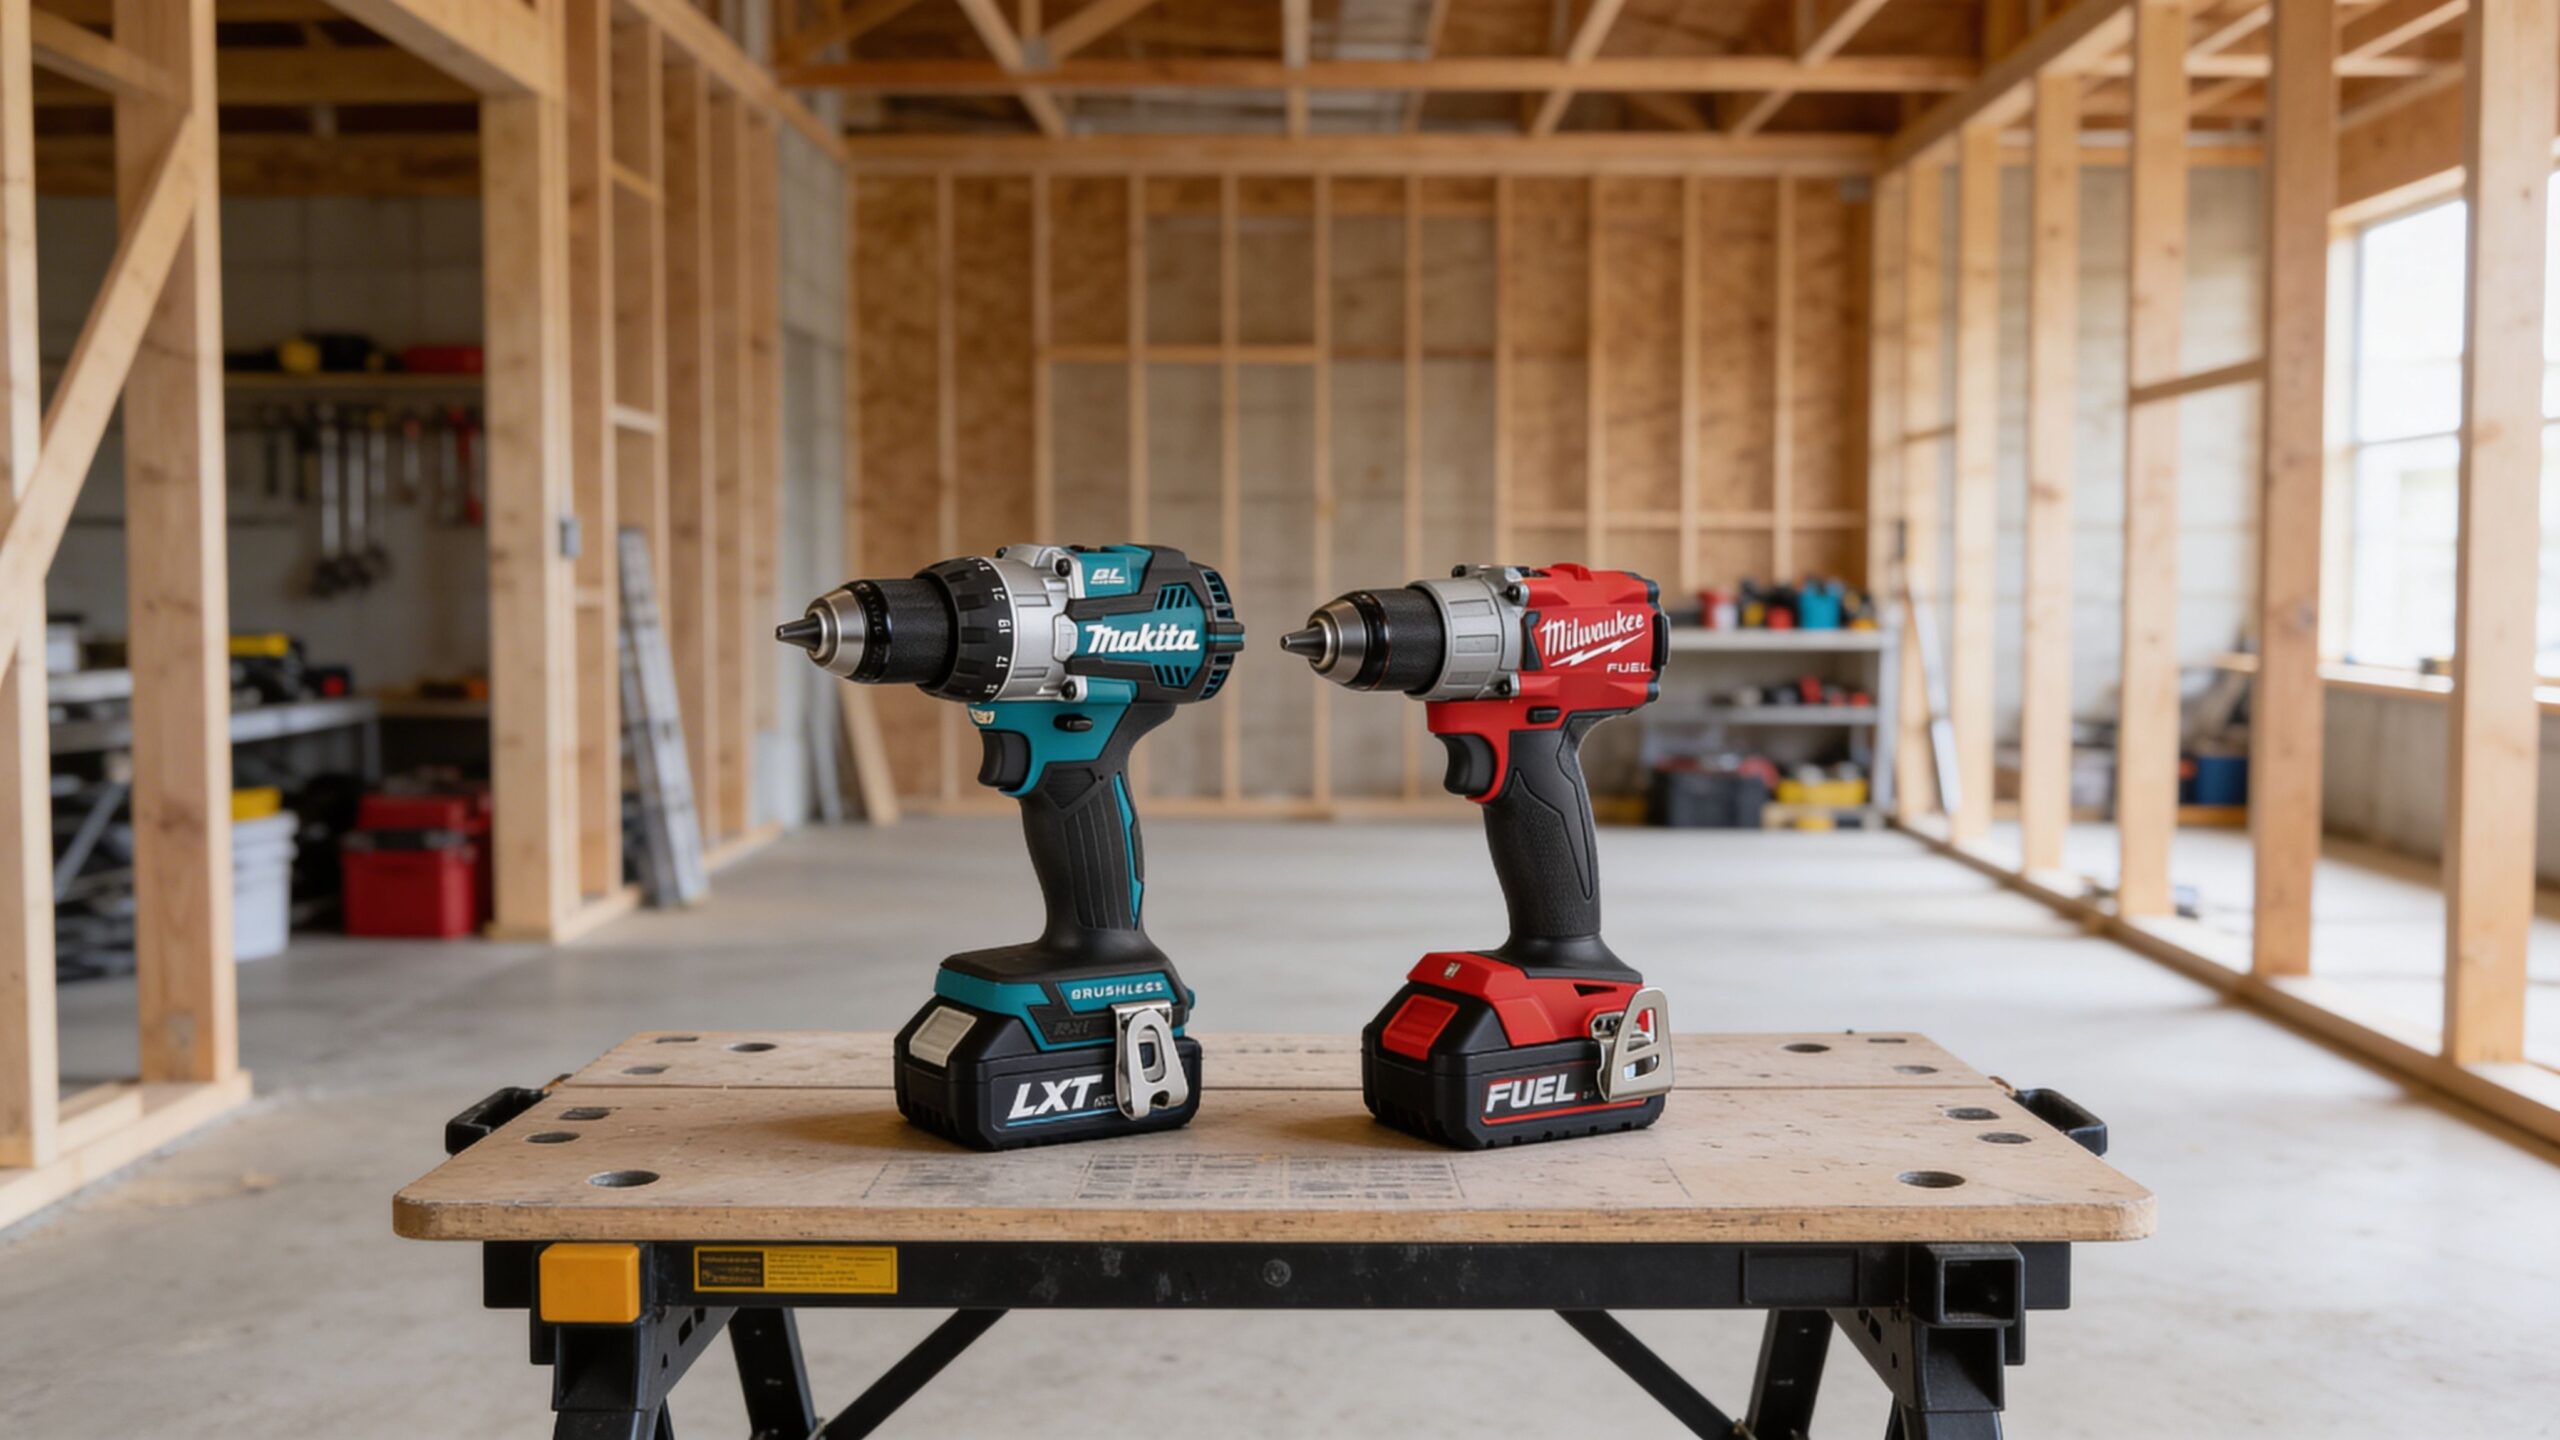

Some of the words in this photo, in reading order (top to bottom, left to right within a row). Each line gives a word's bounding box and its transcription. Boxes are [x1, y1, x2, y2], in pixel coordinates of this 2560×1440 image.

[1085, 623, 1200, 654] Makita
[1540, 609, 1645, 657] Milwaukee
[1606, 662, 1650, 673] FUEL
[1071, 981, 1163, 1000] BRUSHLESS
[1007, 1074, 1103, 1119] LXT
[1485, 1073, 1577, 1113] FUEL
